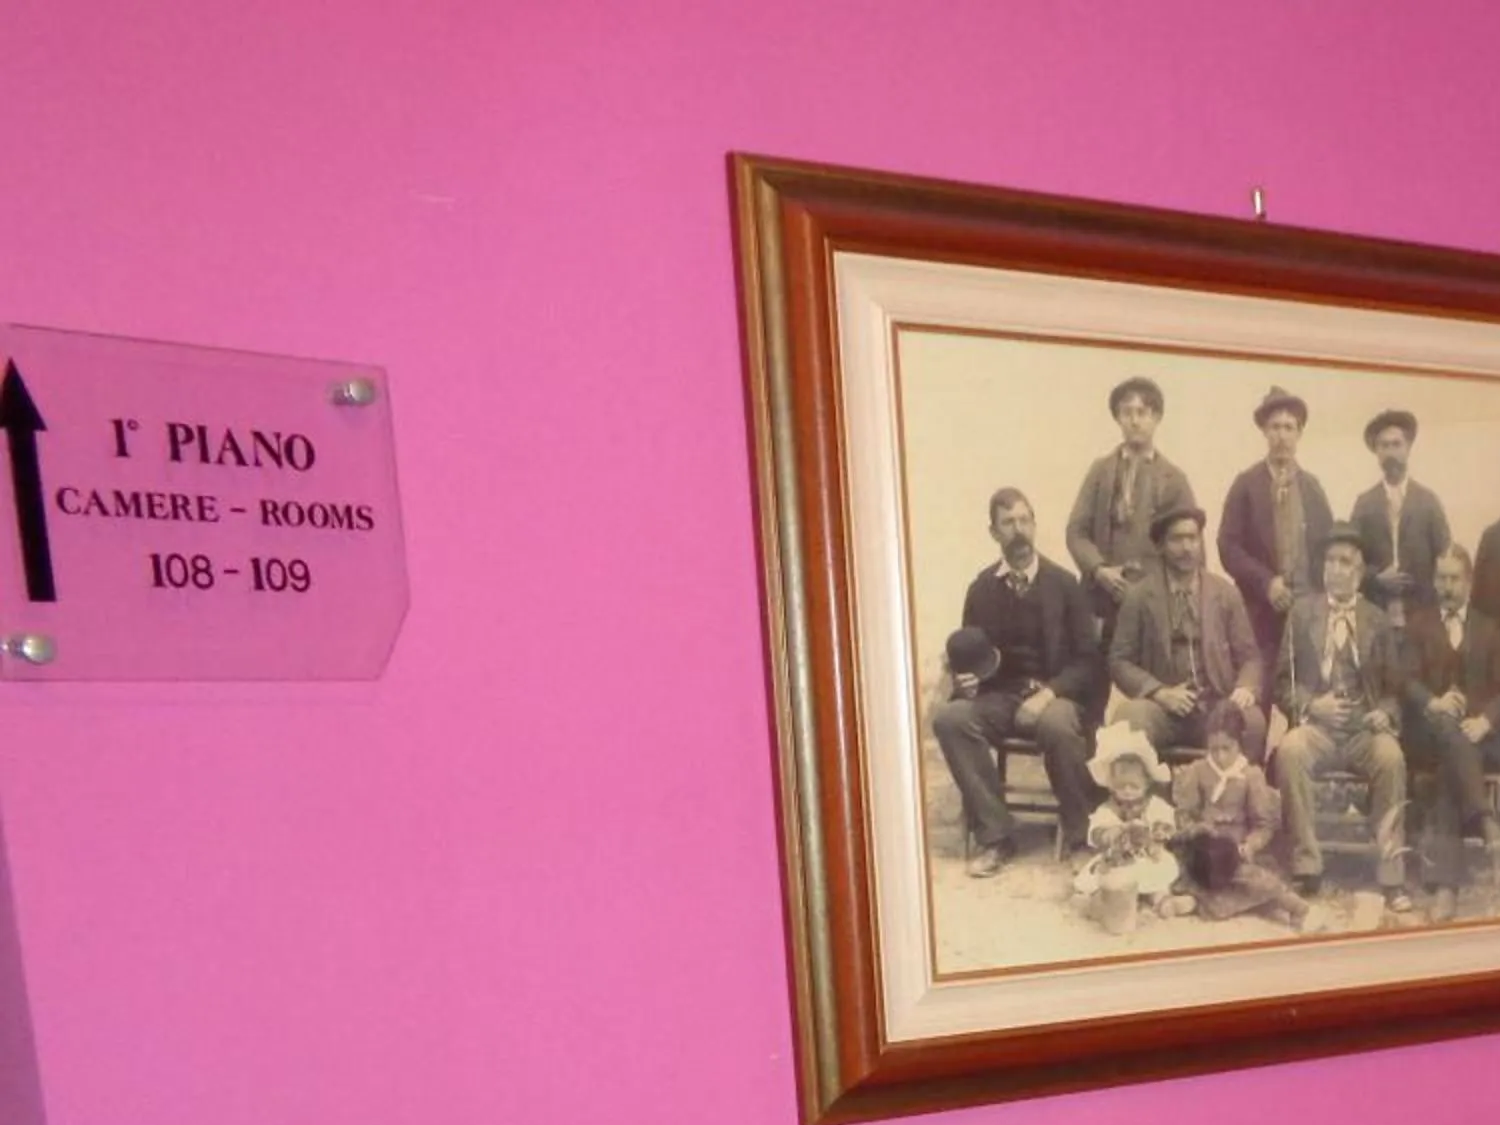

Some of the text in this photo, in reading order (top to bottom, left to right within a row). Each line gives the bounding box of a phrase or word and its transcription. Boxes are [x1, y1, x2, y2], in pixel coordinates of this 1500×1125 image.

[166, 421, 316, 472] PIANO
[56, 486, 220, 524] CAMERE
[260, 499, 375, 531] ROOMS
[149, 552, 214, 590] 108
[250, 556, 311, 592] 109
